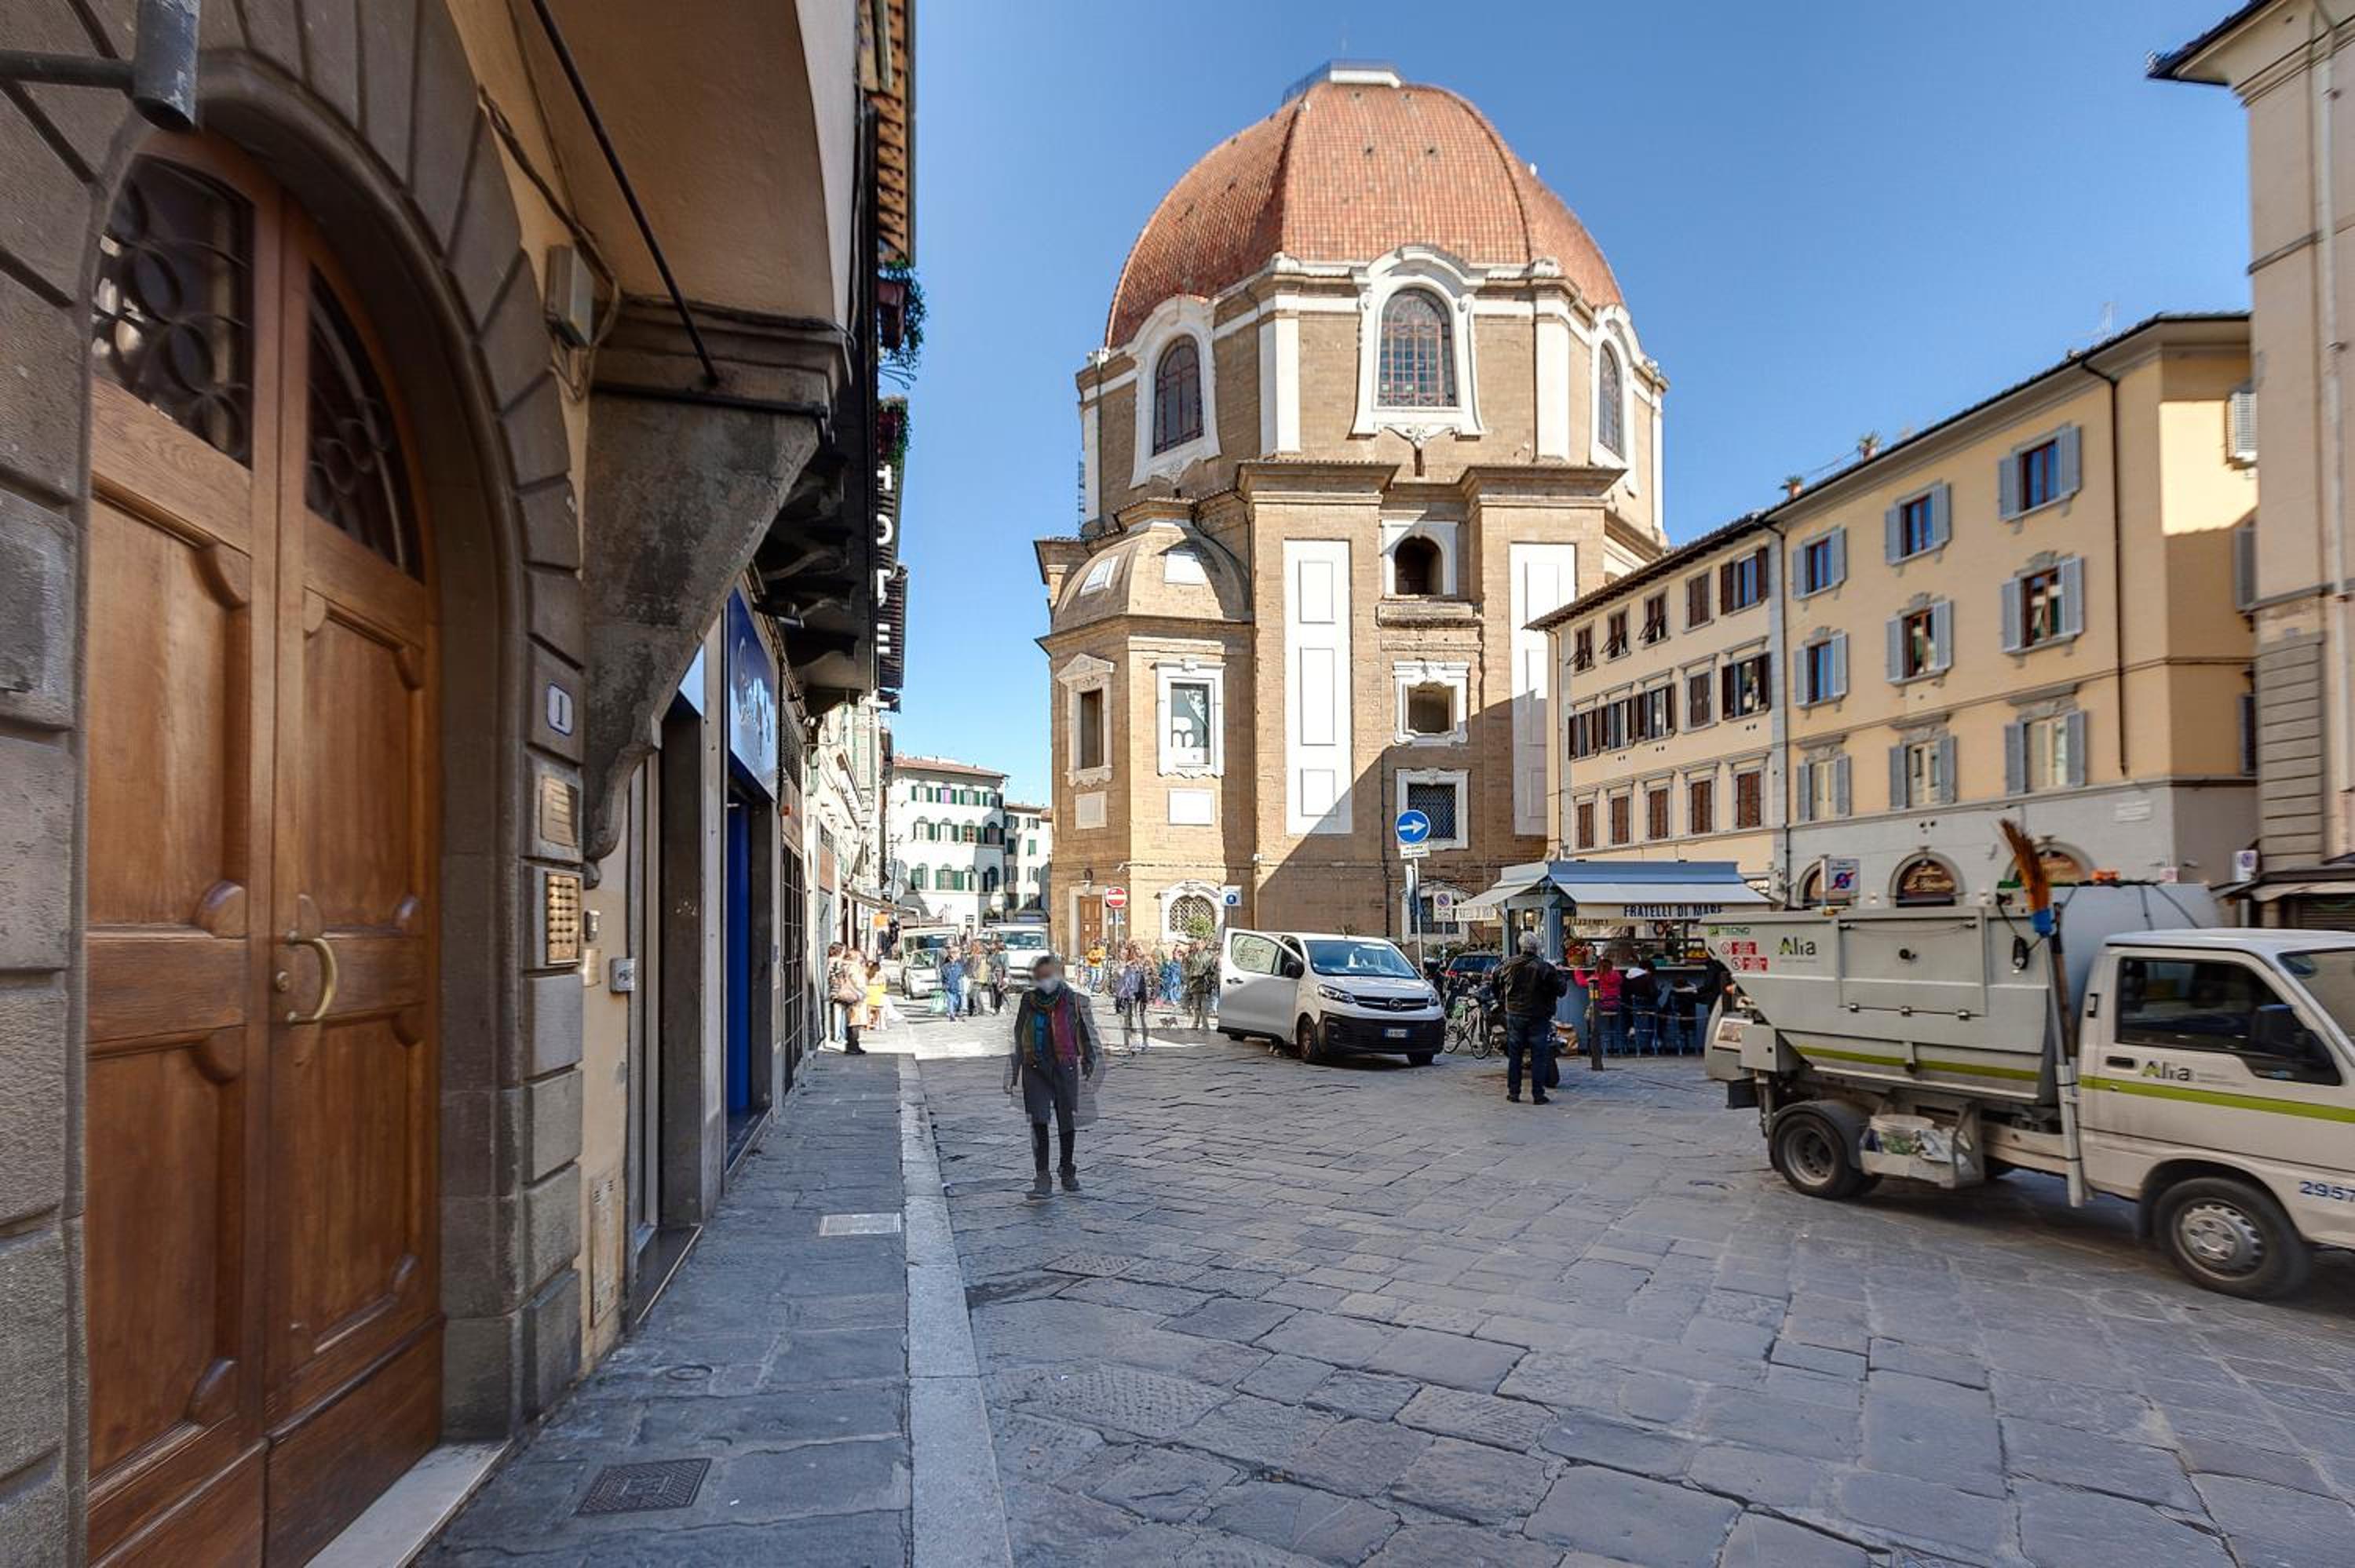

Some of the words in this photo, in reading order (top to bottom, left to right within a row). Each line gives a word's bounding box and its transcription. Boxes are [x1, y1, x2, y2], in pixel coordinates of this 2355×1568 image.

[557, 694, 565, 726] 1
[1623, 904, 1671, 917] FRATELLI
[1678, 904, 1689, 917] DI
[1779, 936, 1816, 955] Alia
[2141, 1060, 2191, 1081] Alia
